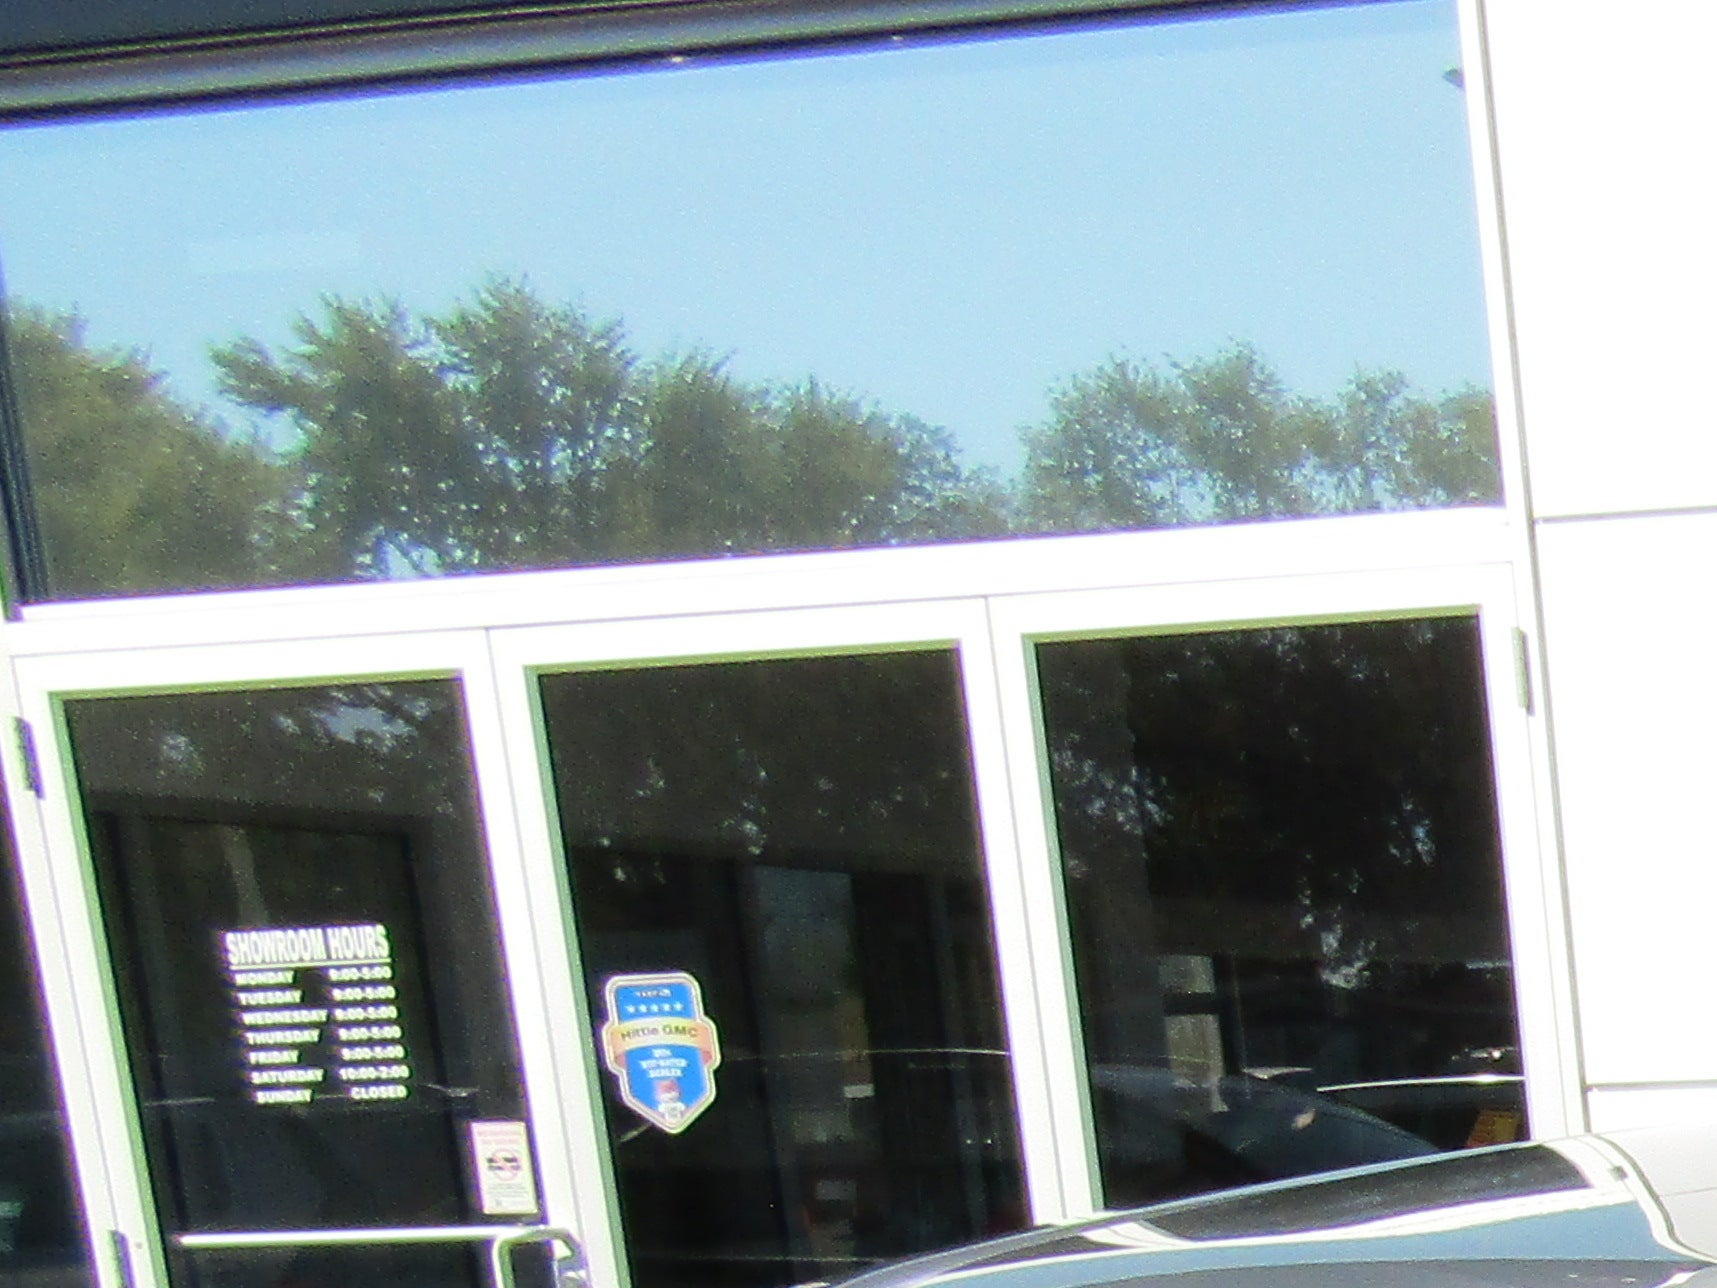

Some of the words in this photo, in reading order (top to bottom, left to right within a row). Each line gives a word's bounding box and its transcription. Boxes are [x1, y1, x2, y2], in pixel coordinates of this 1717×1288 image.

[225, 927, 328, 966] SHOWROOM
[326, 923, 391, 961] HOURS
[234, 969, 295, 987] MONDAY
[237, 988, 303, 1006] TUESDAY
[241, 1008, 329, 1026] WEDNESDAY
[244, 1028, 321, 1046] THURSDAY
[662, 1024, 699, 1039] GMC
[248, 1049, 299, 1066] FRIDAY
[250, 1068, 325, 1086] SATURDAY
[255, 1088, 313, 1105] SUNDAY
[349, 1084, 409, 1101] CLOSED
